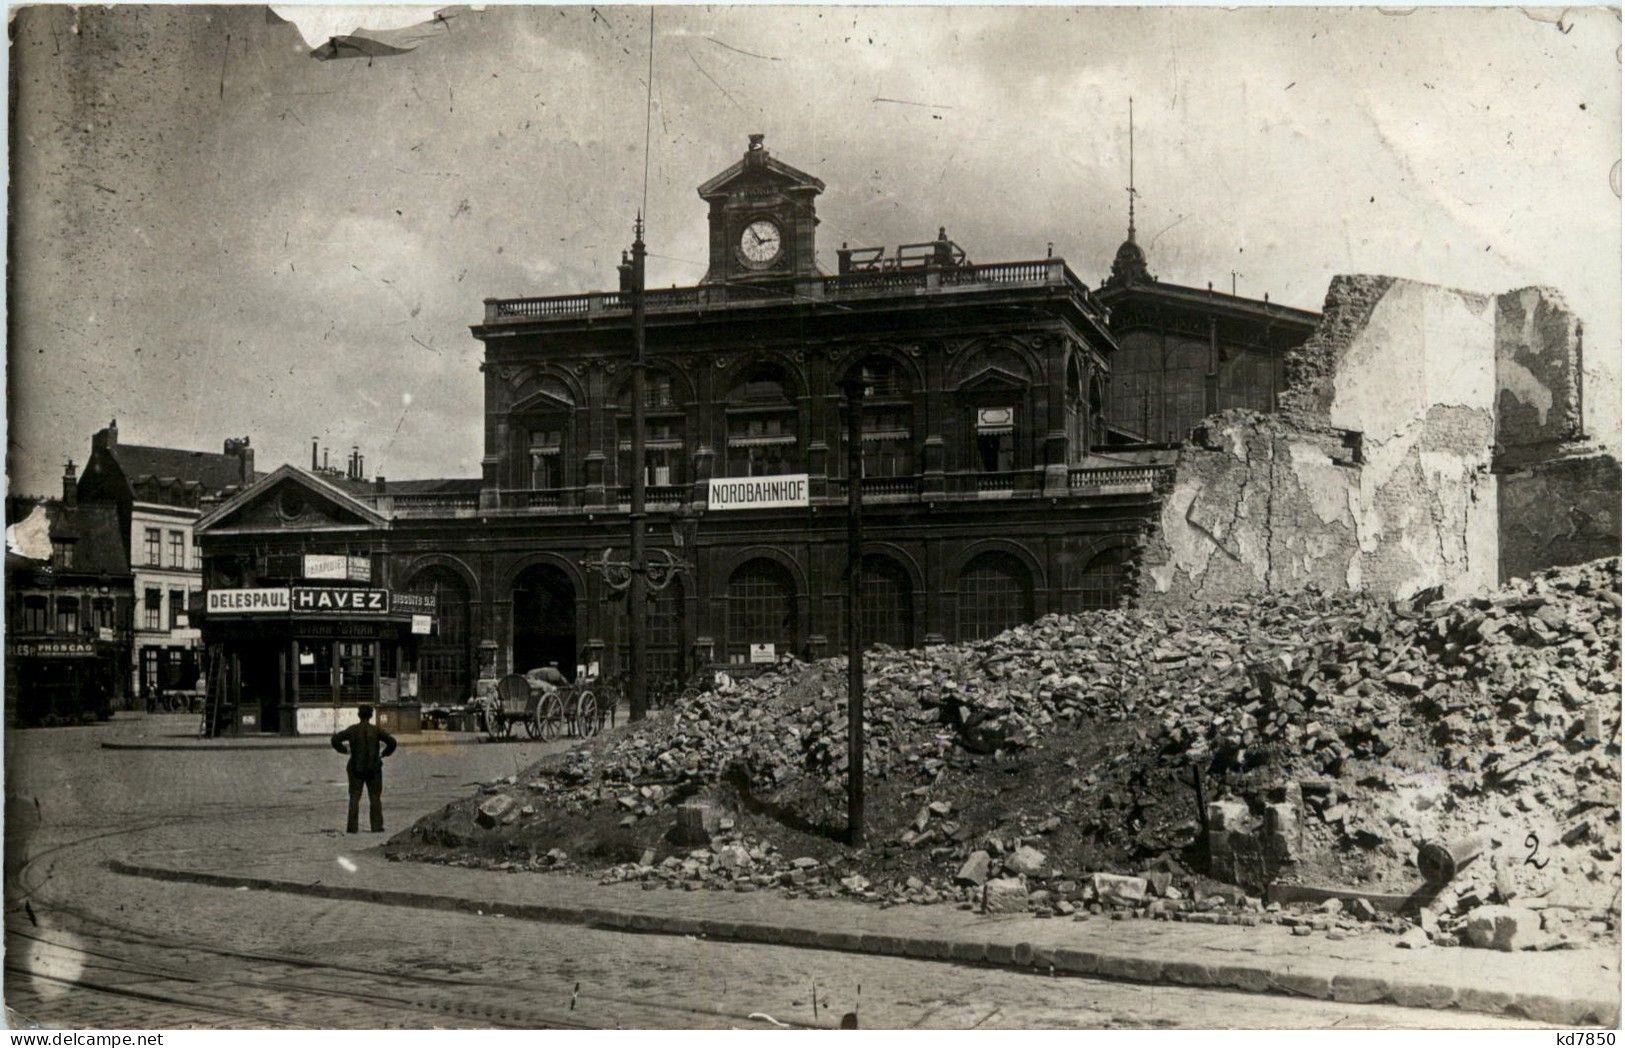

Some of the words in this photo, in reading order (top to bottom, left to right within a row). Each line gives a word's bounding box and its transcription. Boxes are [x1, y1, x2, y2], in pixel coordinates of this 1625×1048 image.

[210, 592, 287, 609] DELESPAUL
[299, 591, 382, 608] HAVEZ
[1523, 831, 1550, 870] 2
